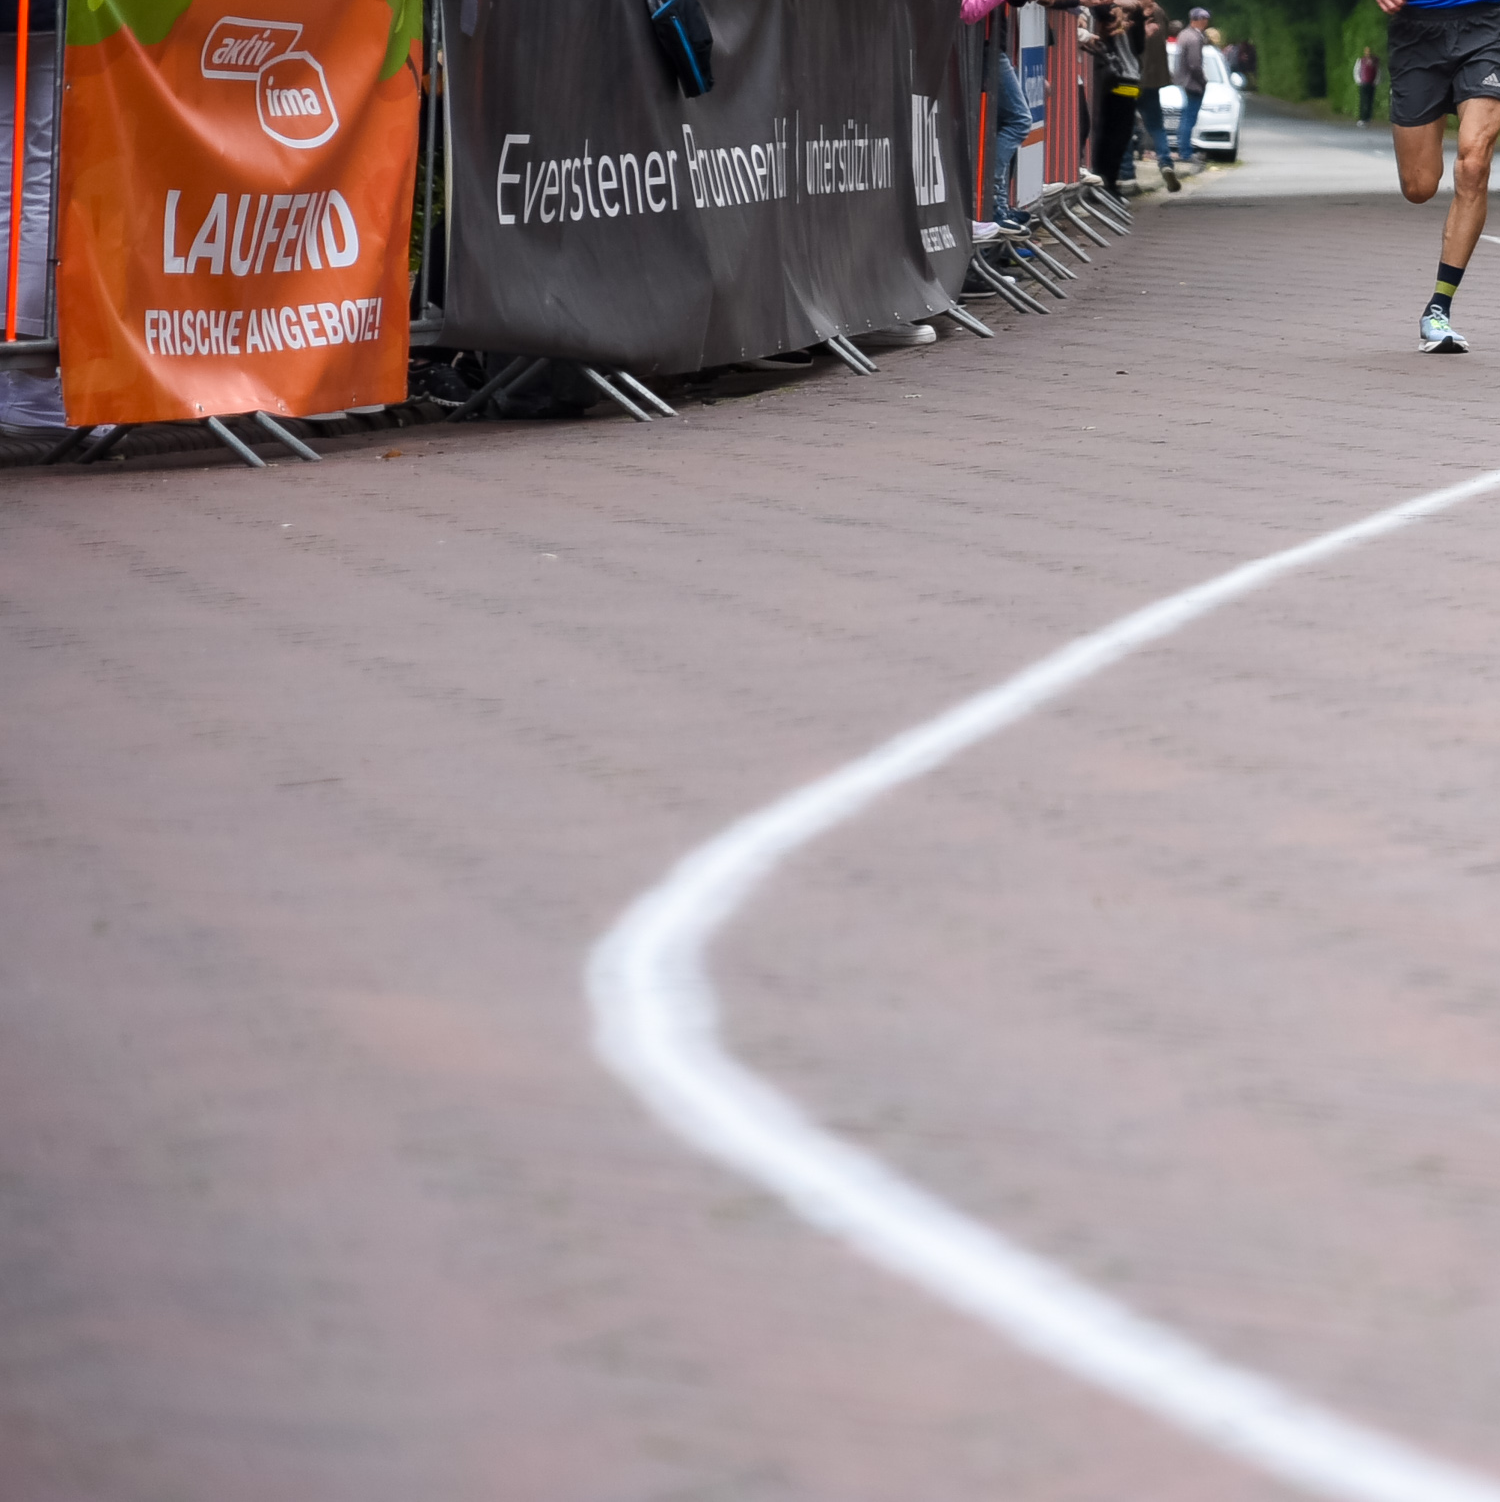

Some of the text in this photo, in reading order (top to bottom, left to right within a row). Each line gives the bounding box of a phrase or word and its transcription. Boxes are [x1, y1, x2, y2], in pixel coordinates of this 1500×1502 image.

[211, 29, 276, 66] aktiv
[265, 75, 322, 117] irma
[497, 134, 677, 225] Everstener
[163, 190, 360, 277] LAUFEND
[144, 297, 382, 356] FRISCHE ANGEBOTE!
